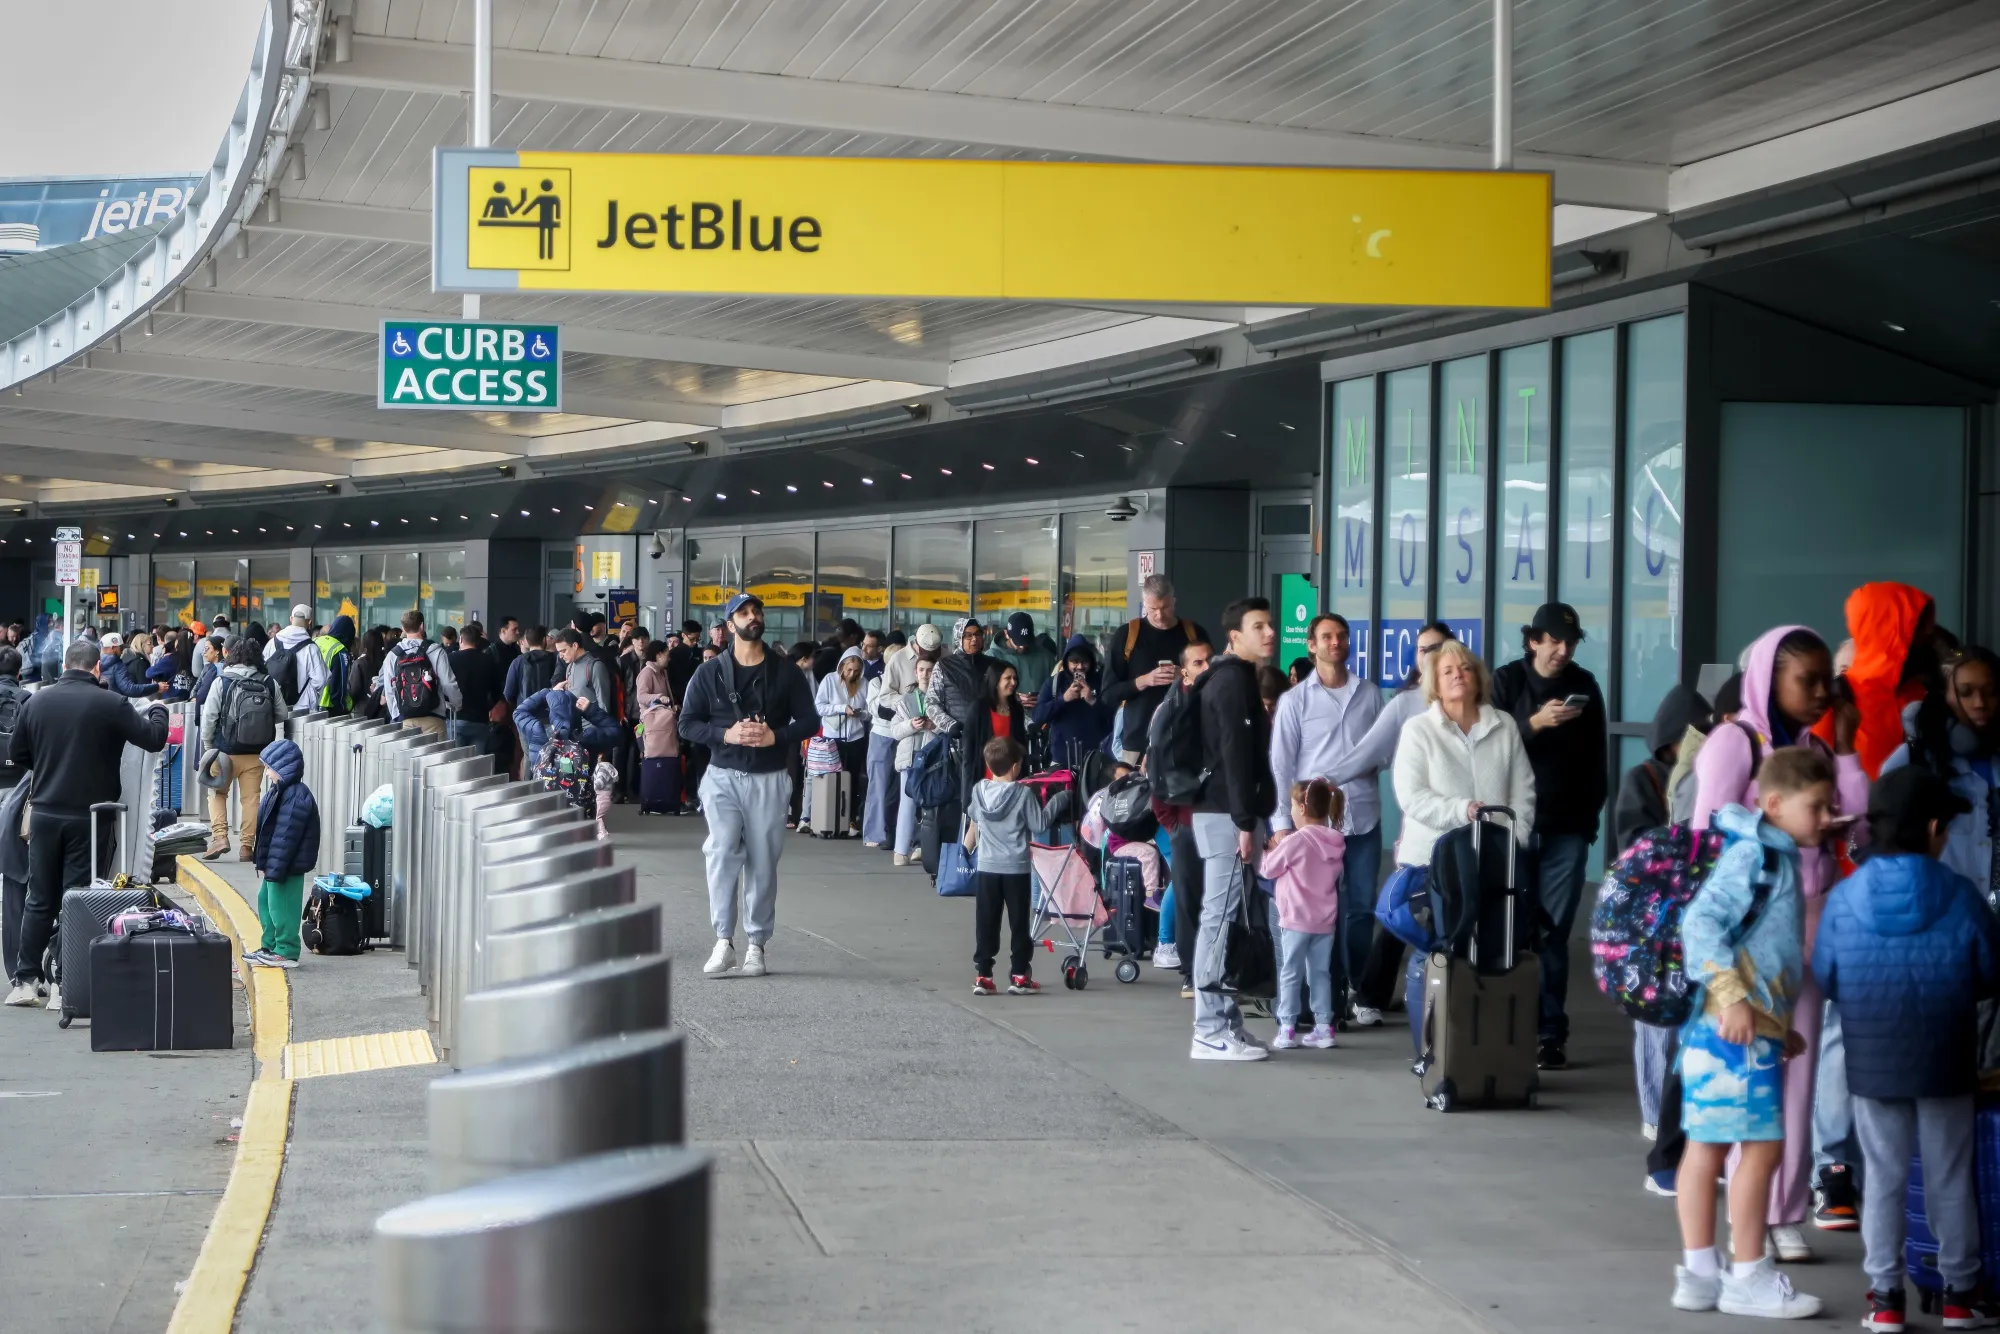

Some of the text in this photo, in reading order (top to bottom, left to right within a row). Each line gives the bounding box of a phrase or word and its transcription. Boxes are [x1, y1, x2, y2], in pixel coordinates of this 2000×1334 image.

[597, 198, 823, 253] JetBlue
[417, 327, 526, 361] CURB
[392, 367, 548, 402] ACCESS
[1346, 387, 1536, 488] MINT
[64, 544, 73, 553] NO
[1344, 486, 1667, 589] MOSAIC
[1140, 555, 1152, 573] FDC
